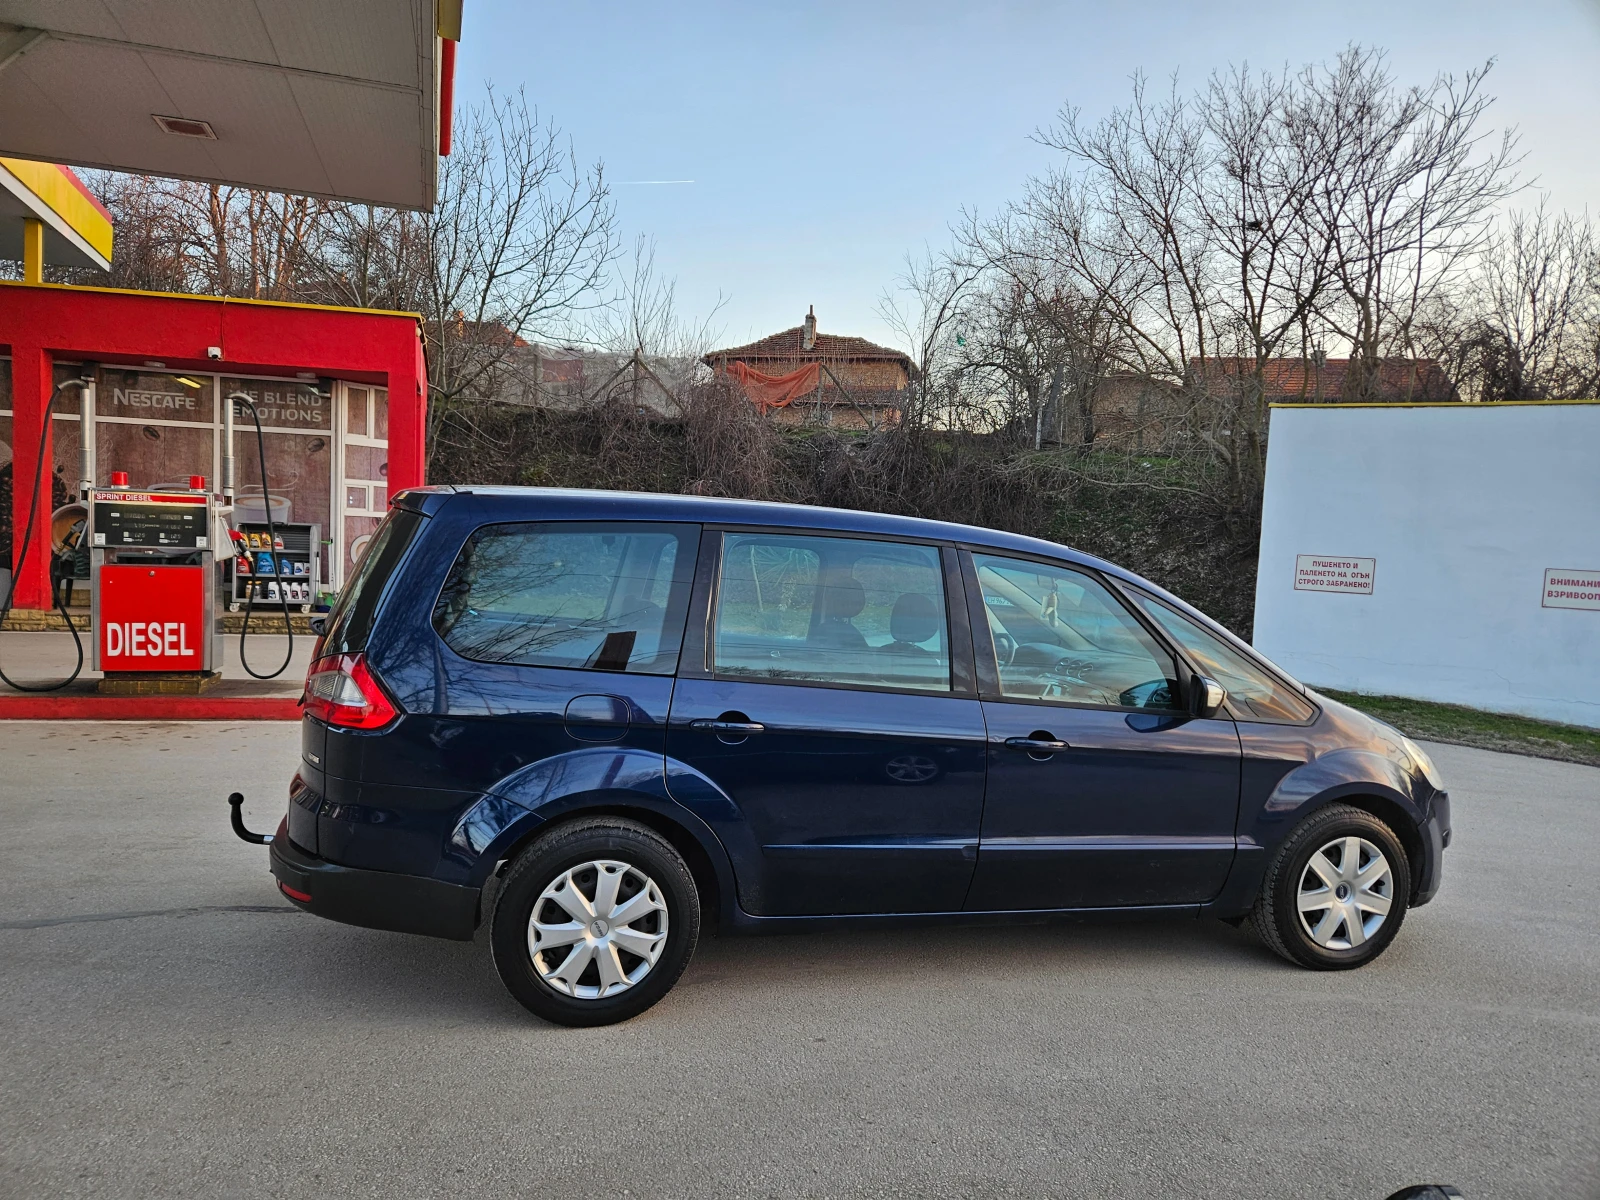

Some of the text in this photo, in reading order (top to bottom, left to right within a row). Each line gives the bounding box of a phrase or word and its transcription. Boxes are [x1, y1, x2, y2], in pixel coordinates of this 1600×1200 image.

[264, 391, 322, 407] BLEND
[232, 405, 323, 422] EMOTIONS
[96, 492, 124, 501] SPRINT
[1299, 569, 1336, 577] ПАЛЕНЕТО
[1350, 571, 1370, 579] ОГЪН
[1326, 580, 1371, 588] ЗАБРАНЕНО!
[106, 621, 195, 657] DIESEL
